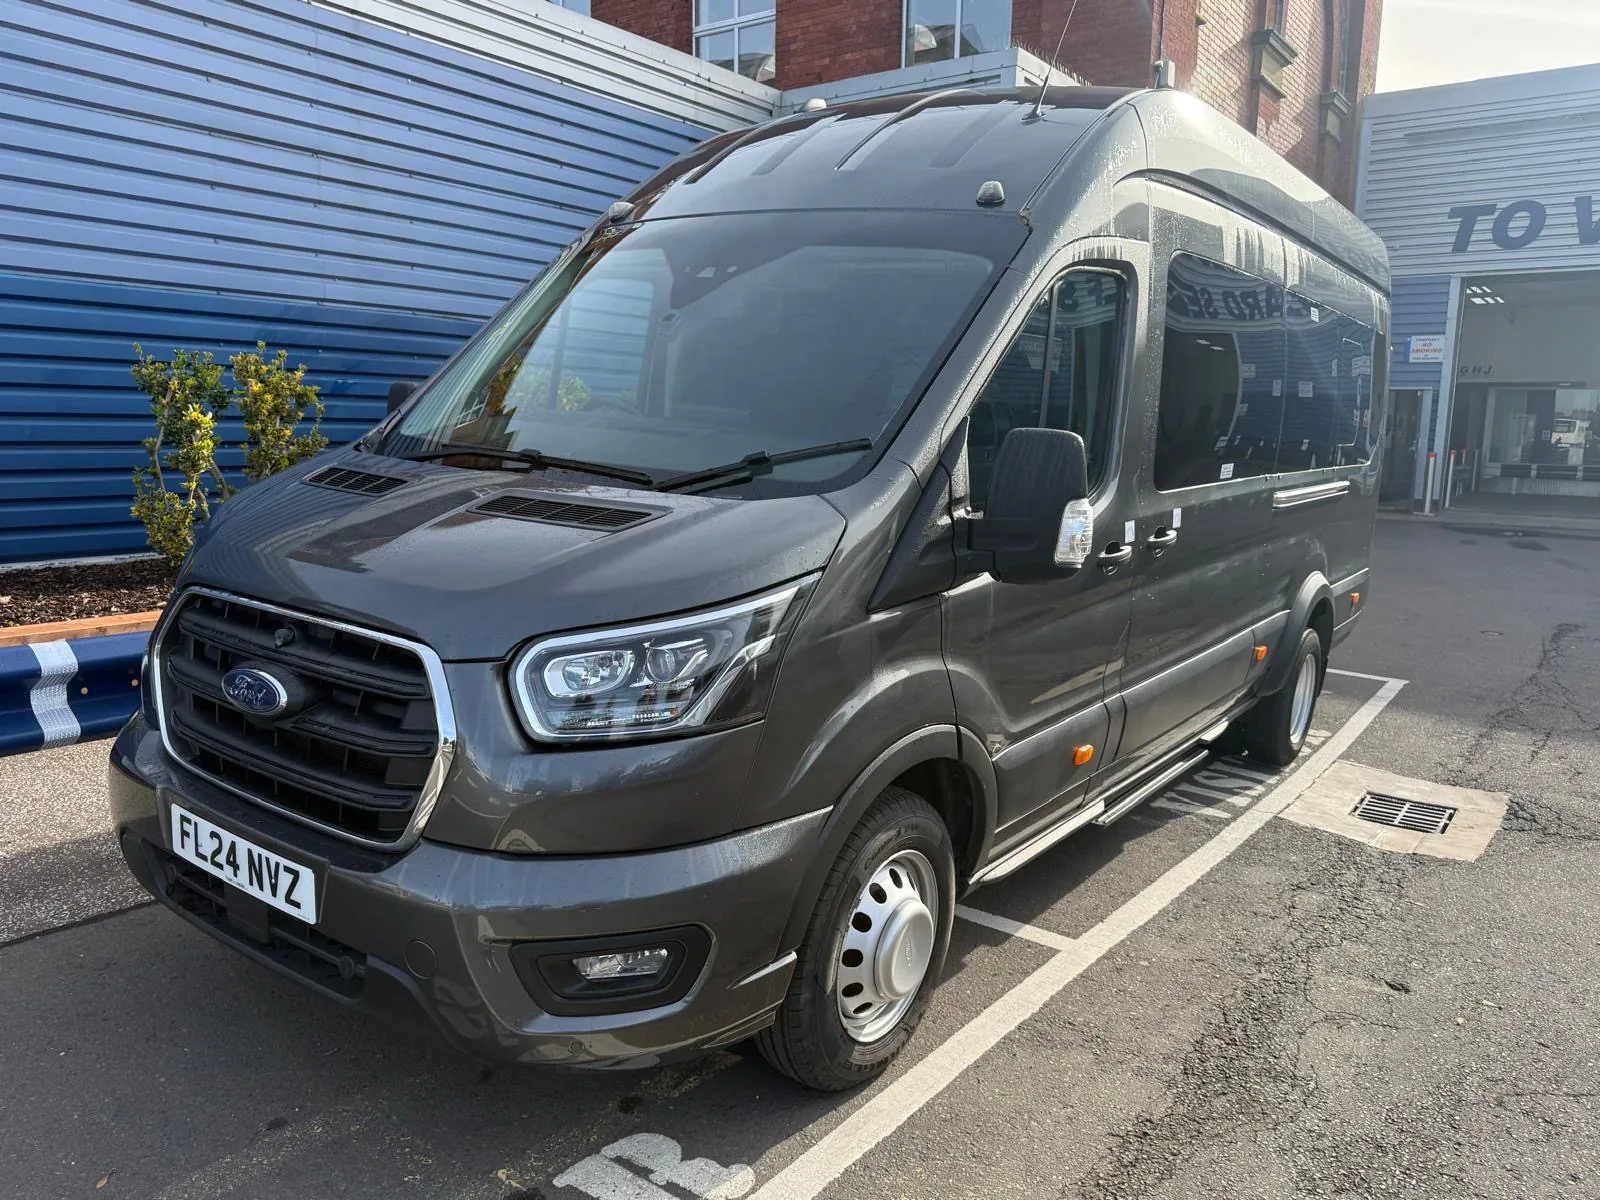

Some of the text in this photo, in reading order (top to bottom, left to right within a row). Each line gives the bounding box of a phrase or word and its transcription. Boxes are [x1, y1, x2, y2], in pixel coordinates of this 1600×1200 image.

[1448, 199, 1547, 253] TO
[179, 813, 302, 910] FL24 NVZ
